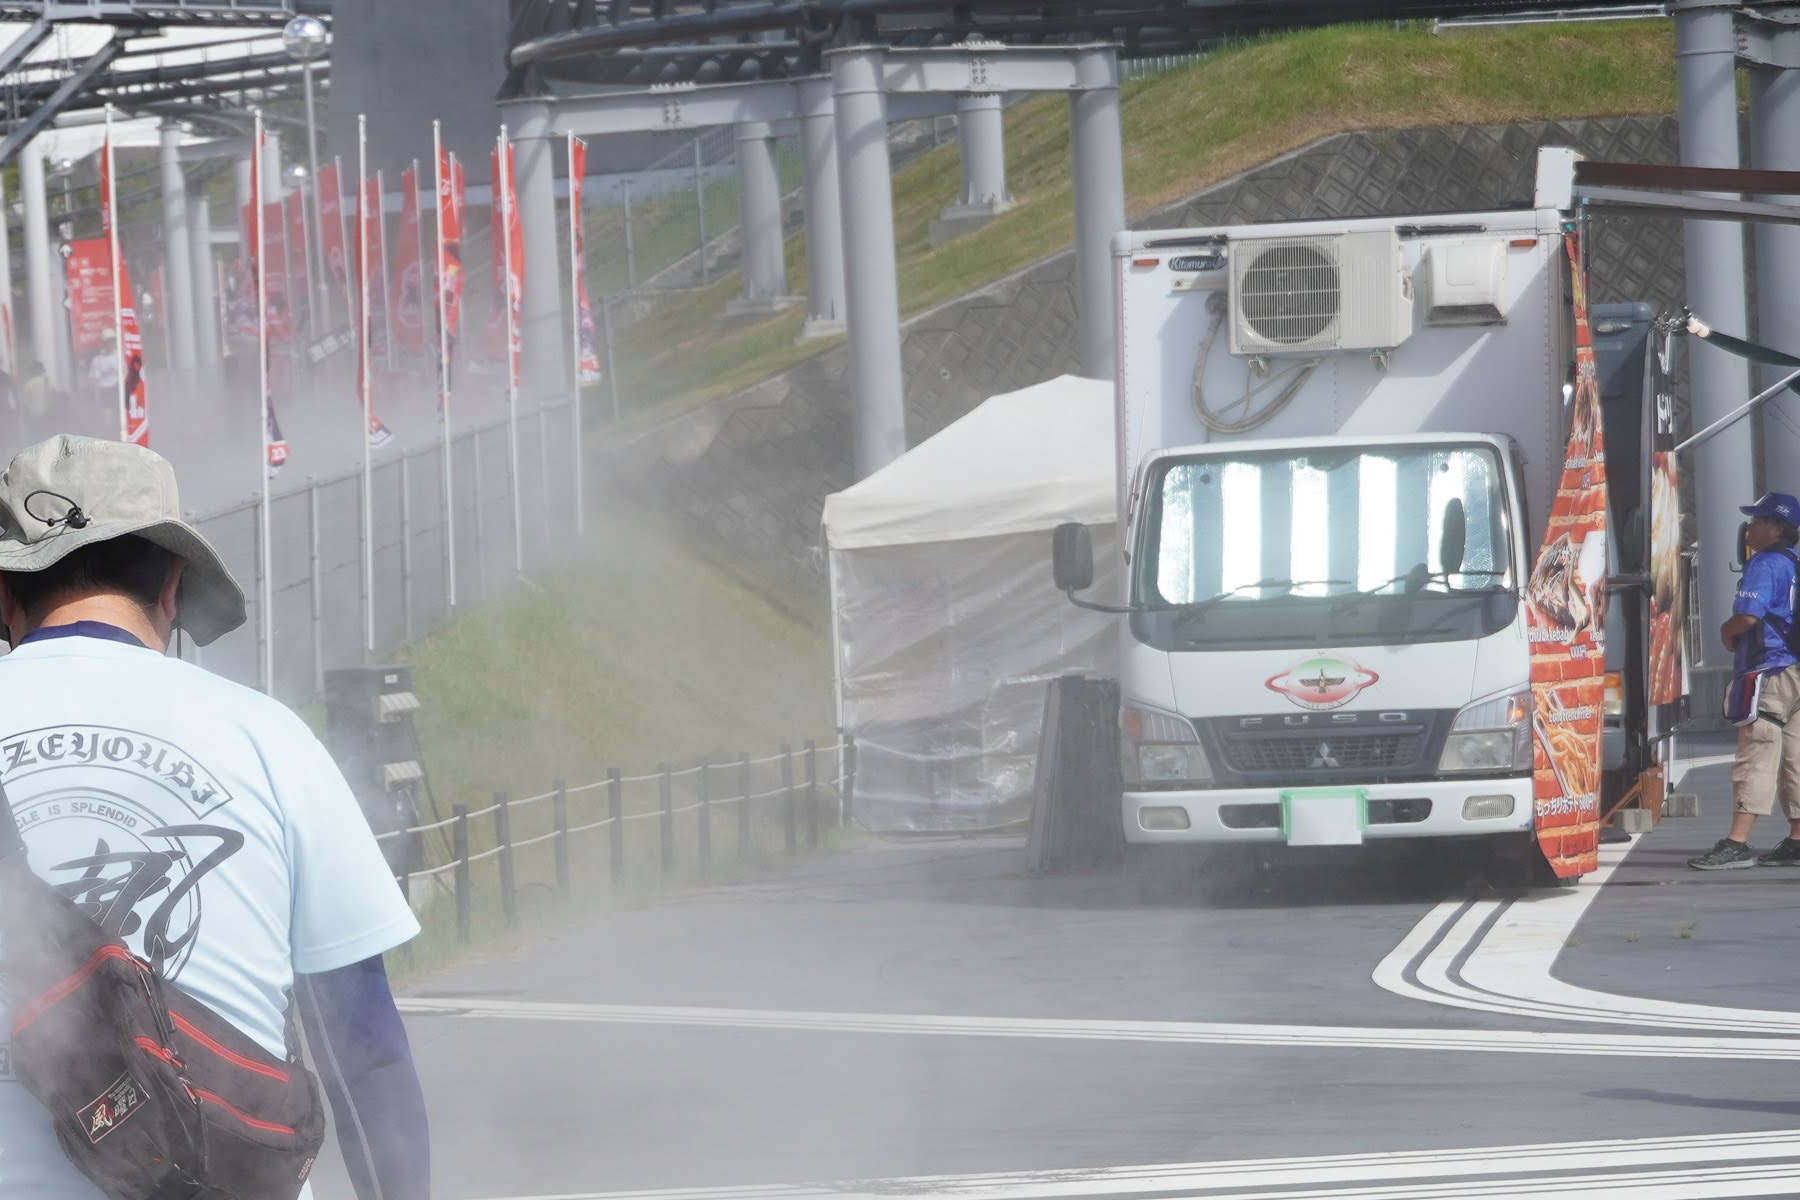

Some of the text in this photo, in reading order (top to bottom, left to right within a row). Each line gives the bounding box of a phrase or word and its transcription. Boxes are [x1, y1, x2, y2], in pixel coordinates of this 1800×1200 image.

[1239, 712, 1407, 729] FUSO
[48, 802, 62, 817] IS
[71, 801, 138, 829] SPLENDID
